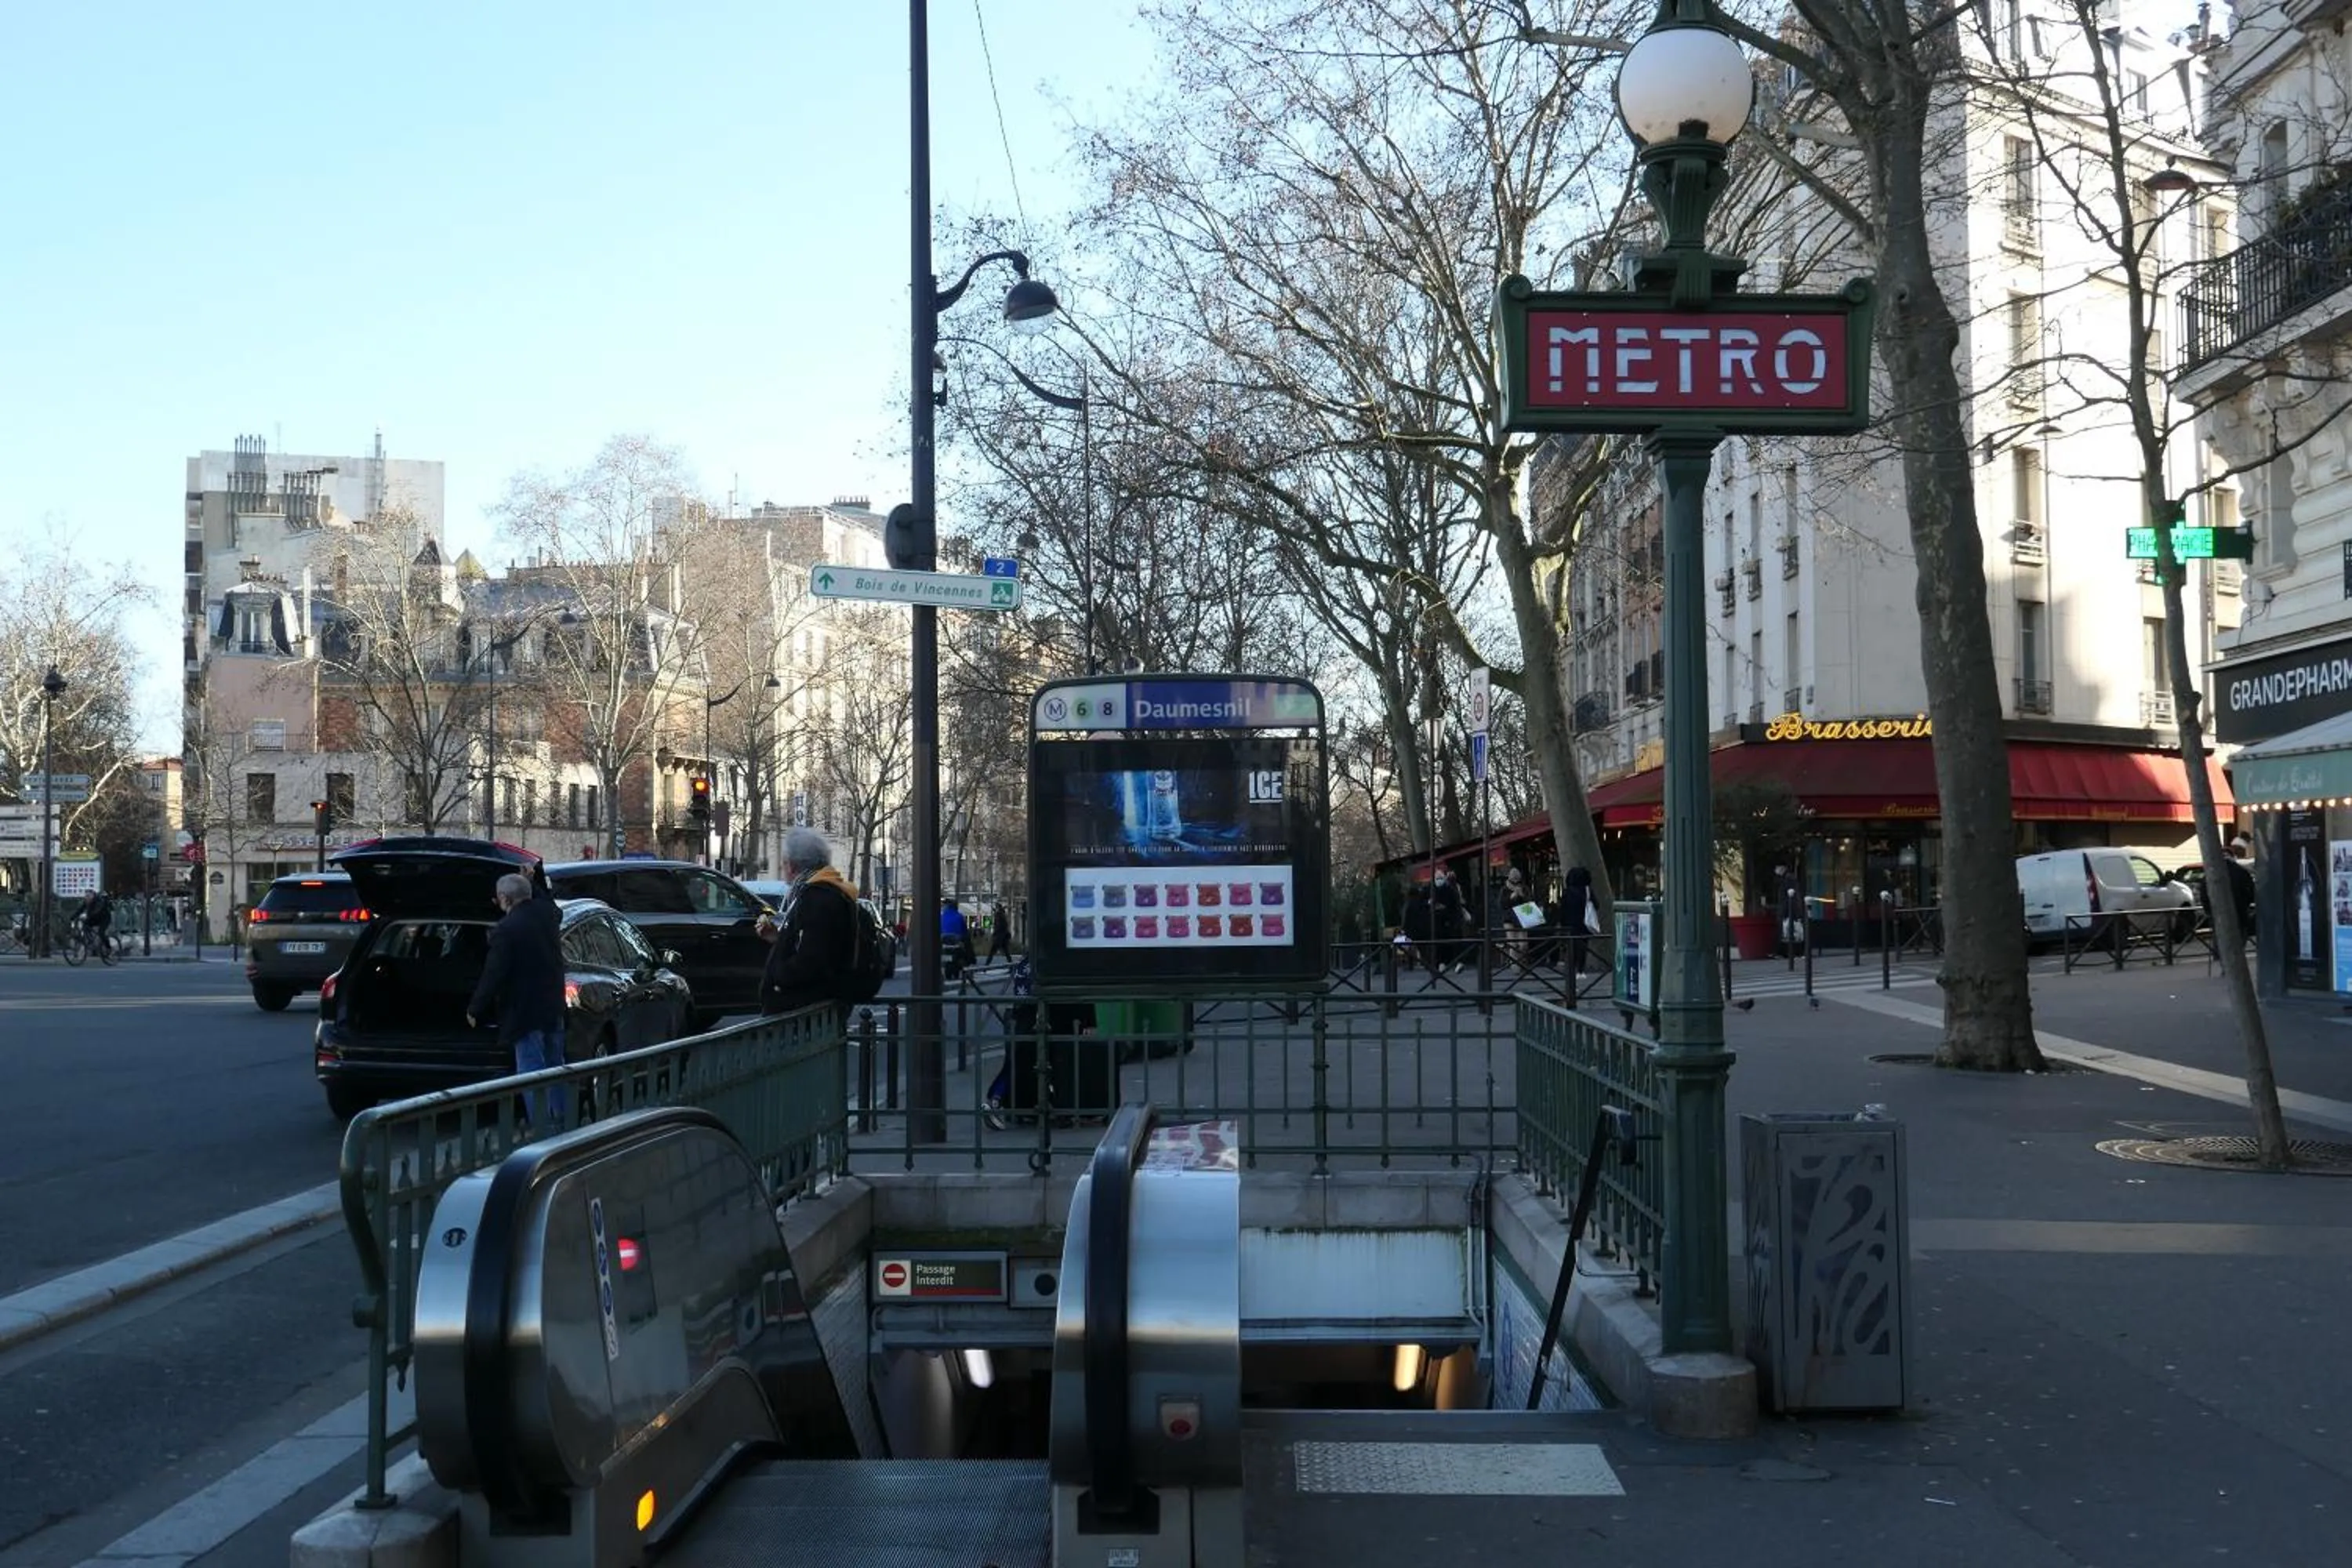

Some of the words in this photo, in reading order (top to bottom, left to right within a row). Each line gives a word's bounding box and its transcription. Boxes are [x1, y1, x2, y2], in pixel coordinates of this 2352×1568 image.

[1548, 326, 1827, 394] METRO
[2130, 533, 2212, 551] PHAACIE
[996, 562, 1005, 574] 2
[855, 577, 884, 591] Bois
[891, 579, 908, 593] de
[913, 581, 983, 599] Vincennes
[1076, 702, 1087, 717] 6
[1102, 702, 1113, 716] 8
[1136, 697, 1252, 719] Daumesnil
[1249, 771, 1283, 800] ICE
[916, 1264, 956, 1275] Passage
[916, 1276, 955, 1285] Interdit
